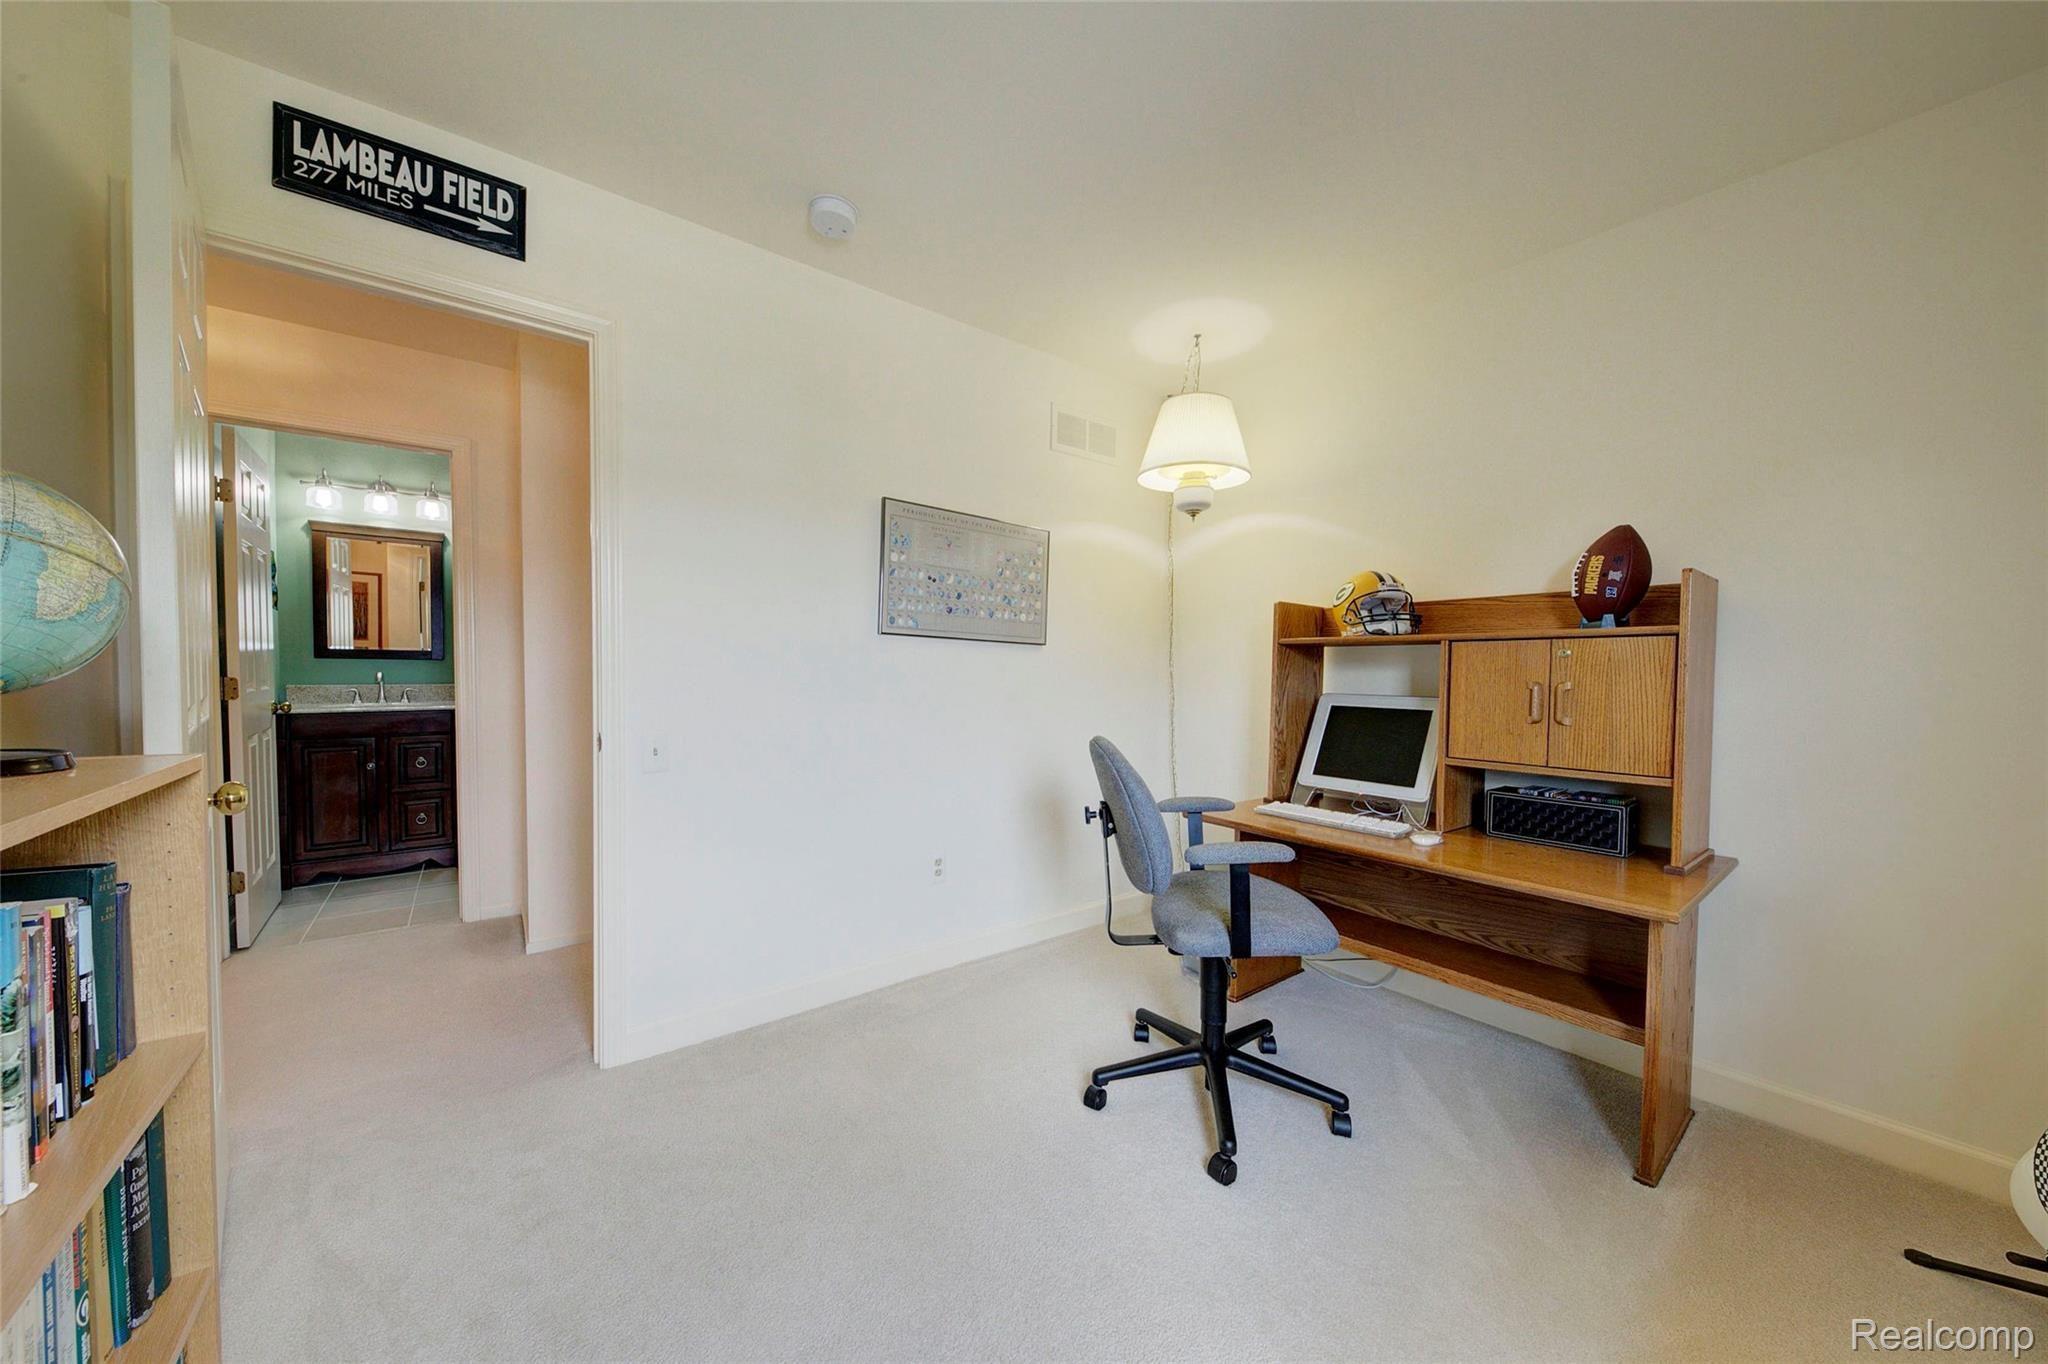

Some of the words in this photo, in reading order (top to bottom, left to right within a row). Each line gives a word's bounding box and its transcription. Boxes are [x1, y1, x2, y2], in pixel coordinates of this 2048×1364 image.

[293, 119, 433, 197] LAMBEAU
[443, 170, 515, 223] FIELD
[293, 159, 337, 184] 277
[346, 174, 414, 210] MILES
[1584, 555, 1605, 595] PACKERS
[69, 945, 78, 1014] SEABISCUIT
